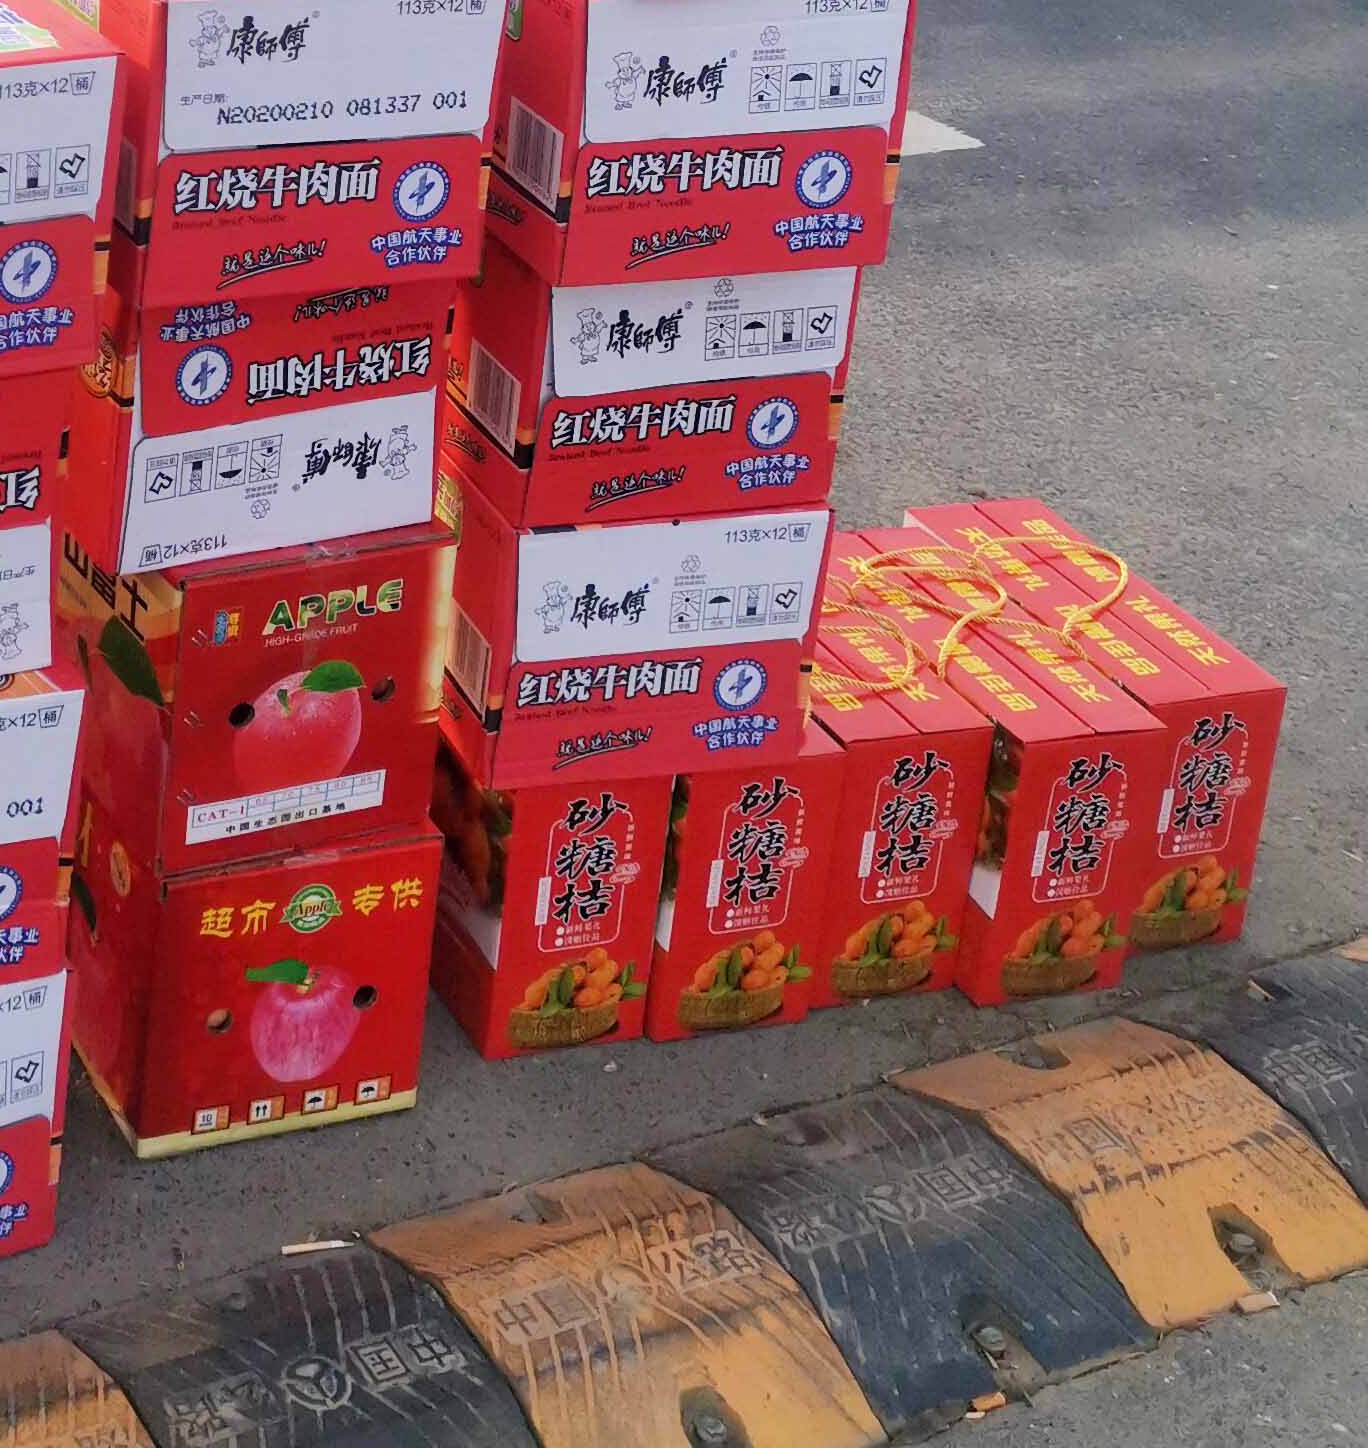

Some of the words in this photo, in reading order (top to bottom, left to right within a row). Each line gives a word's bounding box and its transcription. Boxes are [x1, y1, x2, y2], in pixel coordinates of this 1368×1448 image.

[227, 15, 310, 65] 康師傅
[643, 55, 728, 108] 康師傅
[217, 99, 334, 127] N20200210
[347, 93, 422, 118] 081337
[432, 89, 468, 112] 001
[173, 158, 382, 214] 红烧牛肉面
[586, 146, 783, 199] 红烧牛肉面
[370, 227, 464, 252] 中国航天事业
[773, 212, 864, 237] 中国航天事业
[788, 231, 850, 253] 合作伙伴
[385, 245, 448, 268] 合作伙伴
[159, 313, 252, 344] 中国航天事业
[175, 301, 238, 324] 合作伙伴
[606, 308, 684, 359] 康師傅
[246, 337, 433, 406] 红烧牛肉面
[551, 396, 737, 449] 红烧牛肉面
[724, 454, 810, 478] 中国航天事业
[737, 469, 798, 491] 合作伙伴
[261, 578, 404, 636] APPLE
[570, 583, 650, 631] 康師傅
[517, 658, 703, 708] 红烧牛肉面
[693, 714, 778, 739] 中国航天事业
[706, 730, 765, 752] 合作伙伴
[1173, 712, 1244, 833] 砂糖桔
[6, 796, 45, 820] 001
[875, 751, 951, 878] 砂糖桔
[1048, 752, 1124, 878] 砂糖桔
[553, 792, 630, 924] 砂糖桔
[723, 777, 801, 906] 砂糖桔
[199, 899, 276, 938] 超市
[294, 897, 330, 918] Apple
[352, 876, 424, 916] 专供
[346, 1326, 460, 1390] 中国
